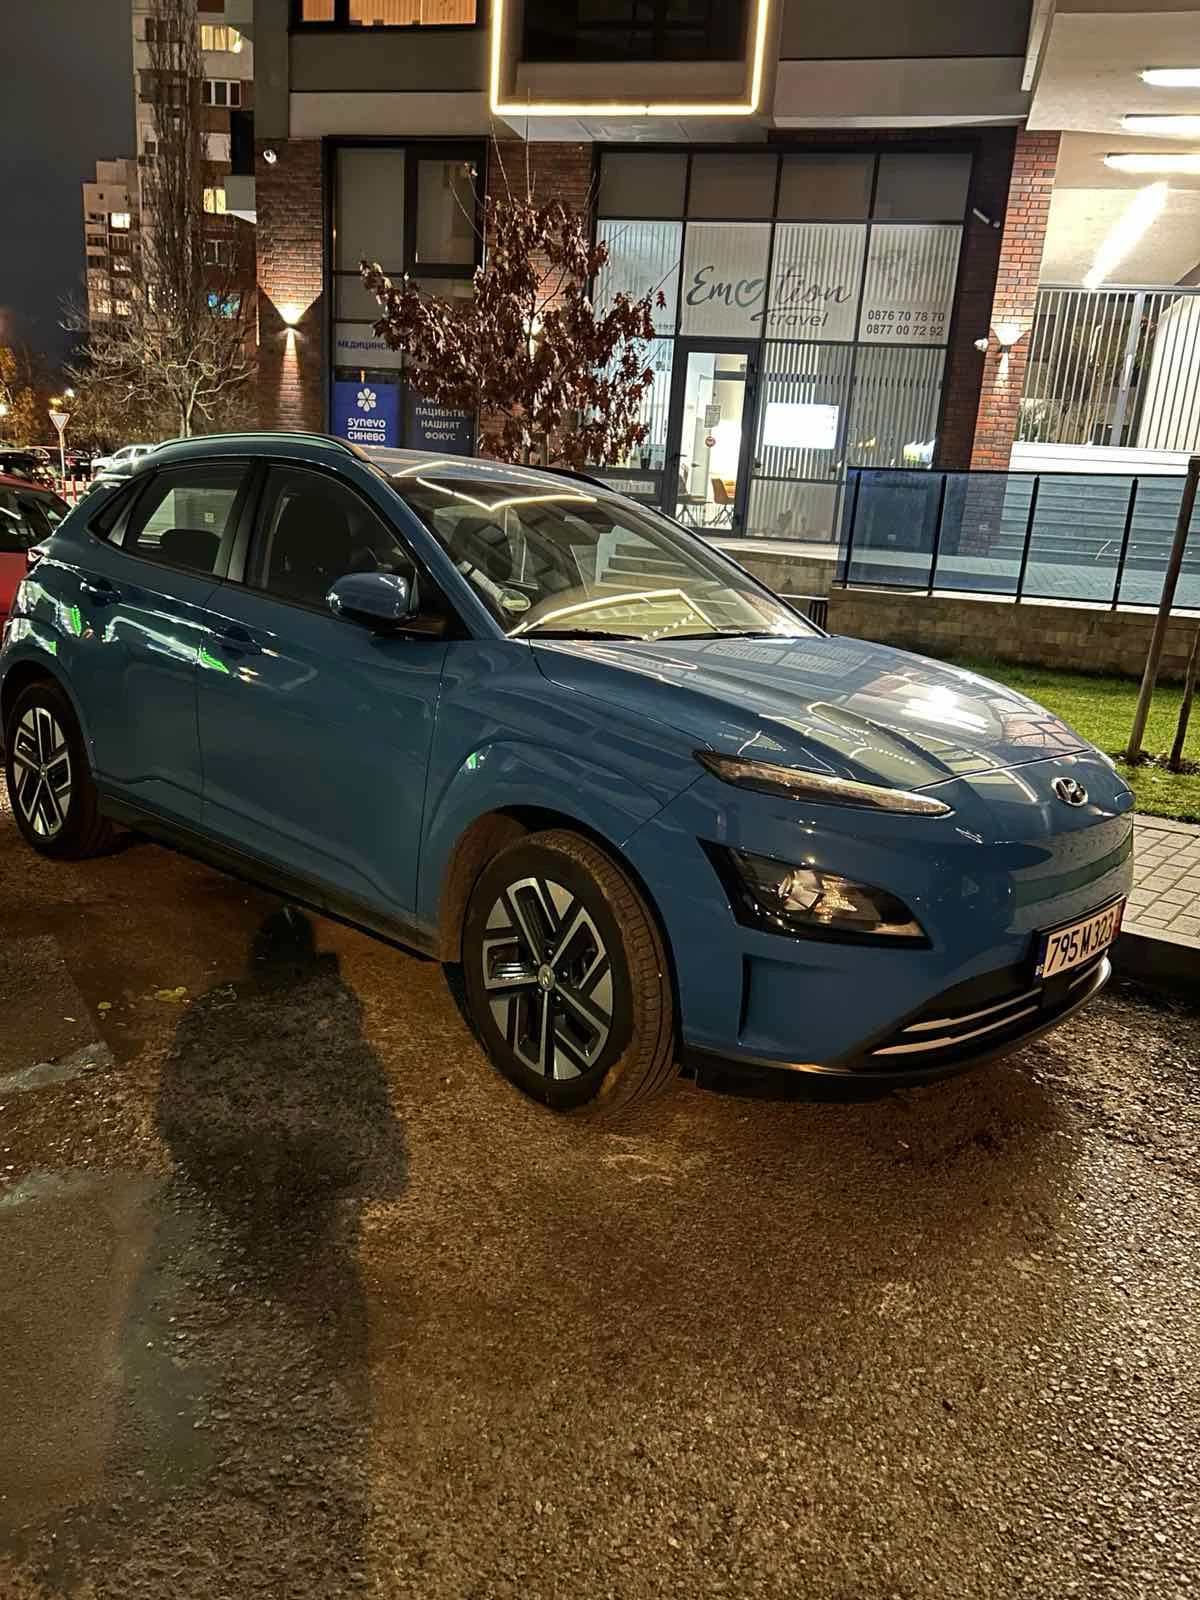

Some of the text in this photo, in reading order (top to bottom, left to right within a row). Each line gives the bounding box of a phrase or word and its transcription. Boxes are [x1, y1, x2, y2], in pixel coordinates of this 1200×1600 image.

[686, 265, 852, 308] Emotion
[769, 312, 829, 328] travel
[867, 309, 945, 323] 0876 70 78 70
[866, 324, 944, 337] 0877 00 72 92
[337, 339, 388, 350] МЕДИЦИНС
[415, 407, 465, 418] ПАЦИЕНТИ
[347, 417, 386, 429] synevo
[421, 420, 461, 430] НАШИЯТ
[425, 431, 456, 441] ФОКУС
